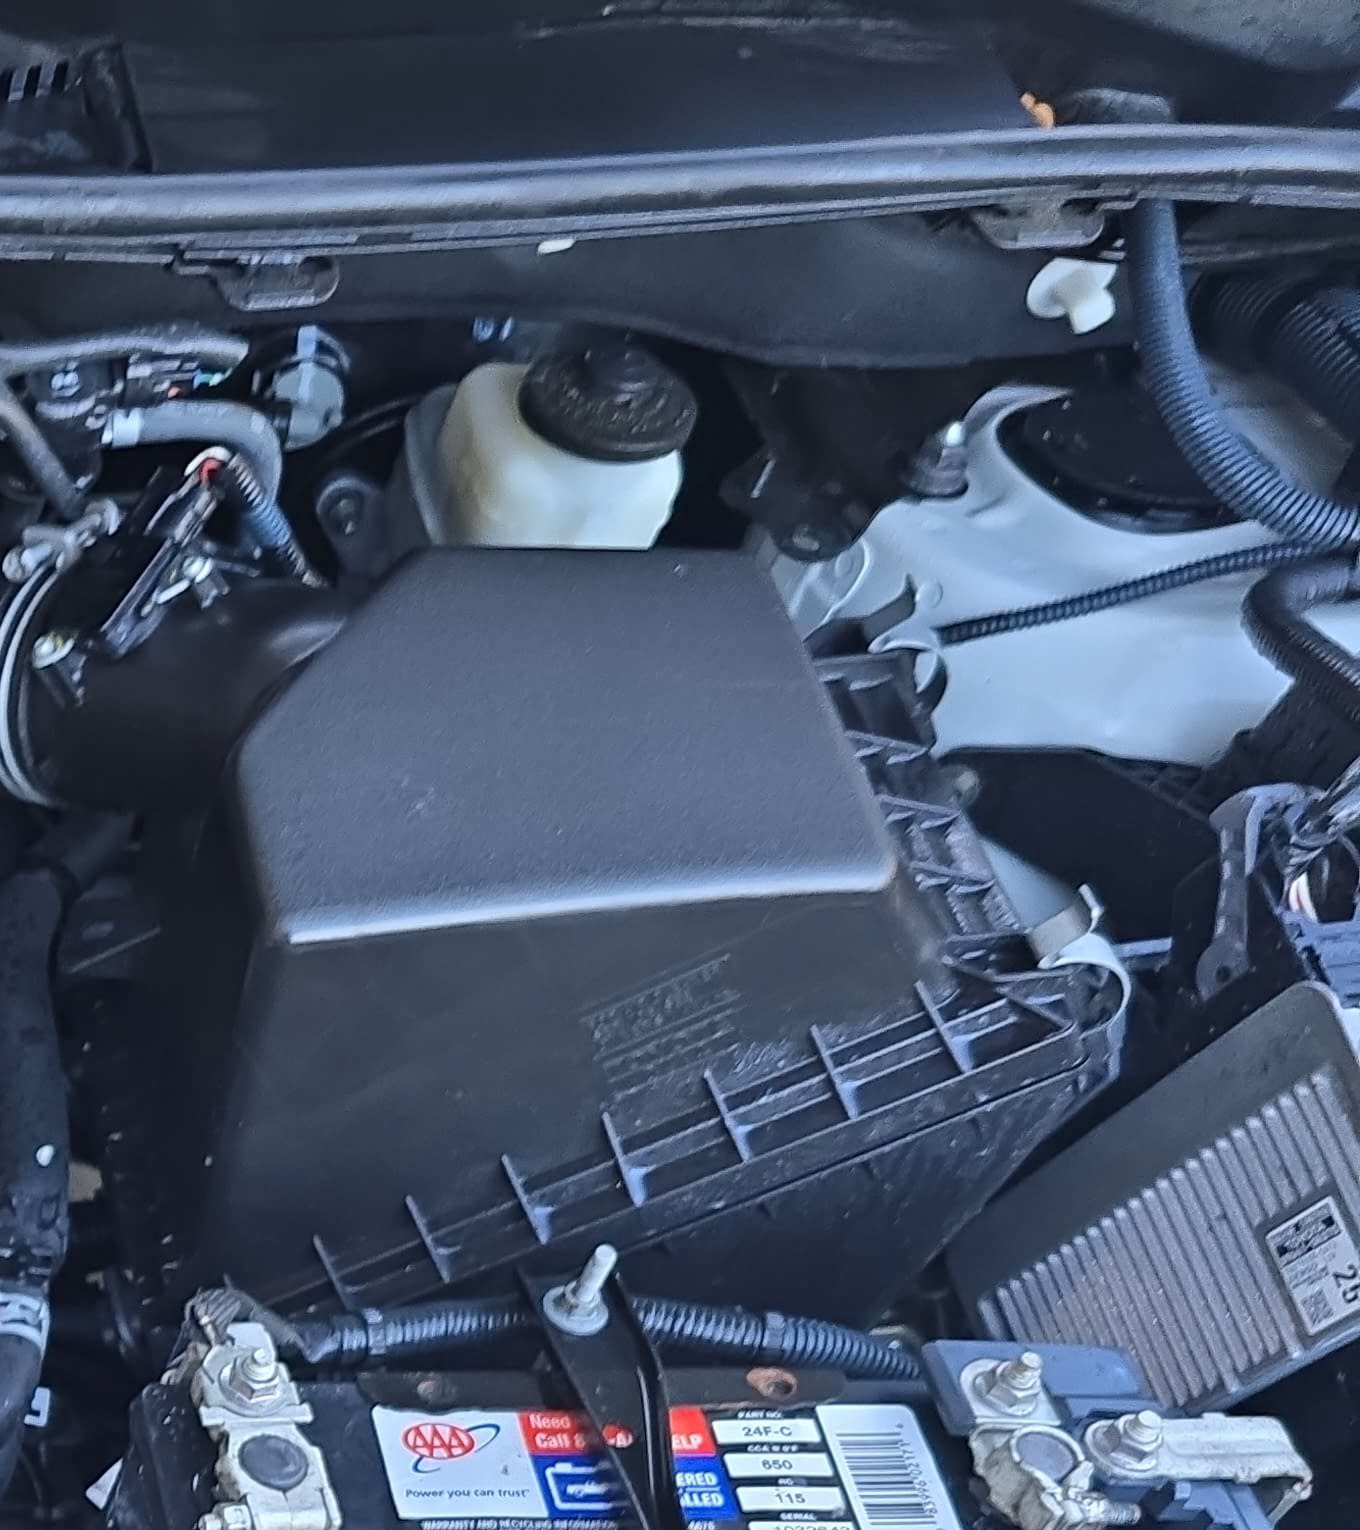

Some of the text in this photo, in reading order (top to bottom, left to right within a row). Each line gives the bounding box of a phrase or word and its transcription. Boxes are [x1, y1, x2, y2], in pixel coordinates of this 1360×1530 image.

[742, 1426, 792, 1437] 24F-C
[409, 1424, 474, 1458] AAA
[535, 1432, 571, 1449] Call
[405, 1488, 444, 1498] Power
[446, 1489, 470, 1499] you
[473, 1489, 494, 1497] can
[775, 1493, 806, 1504] 115
